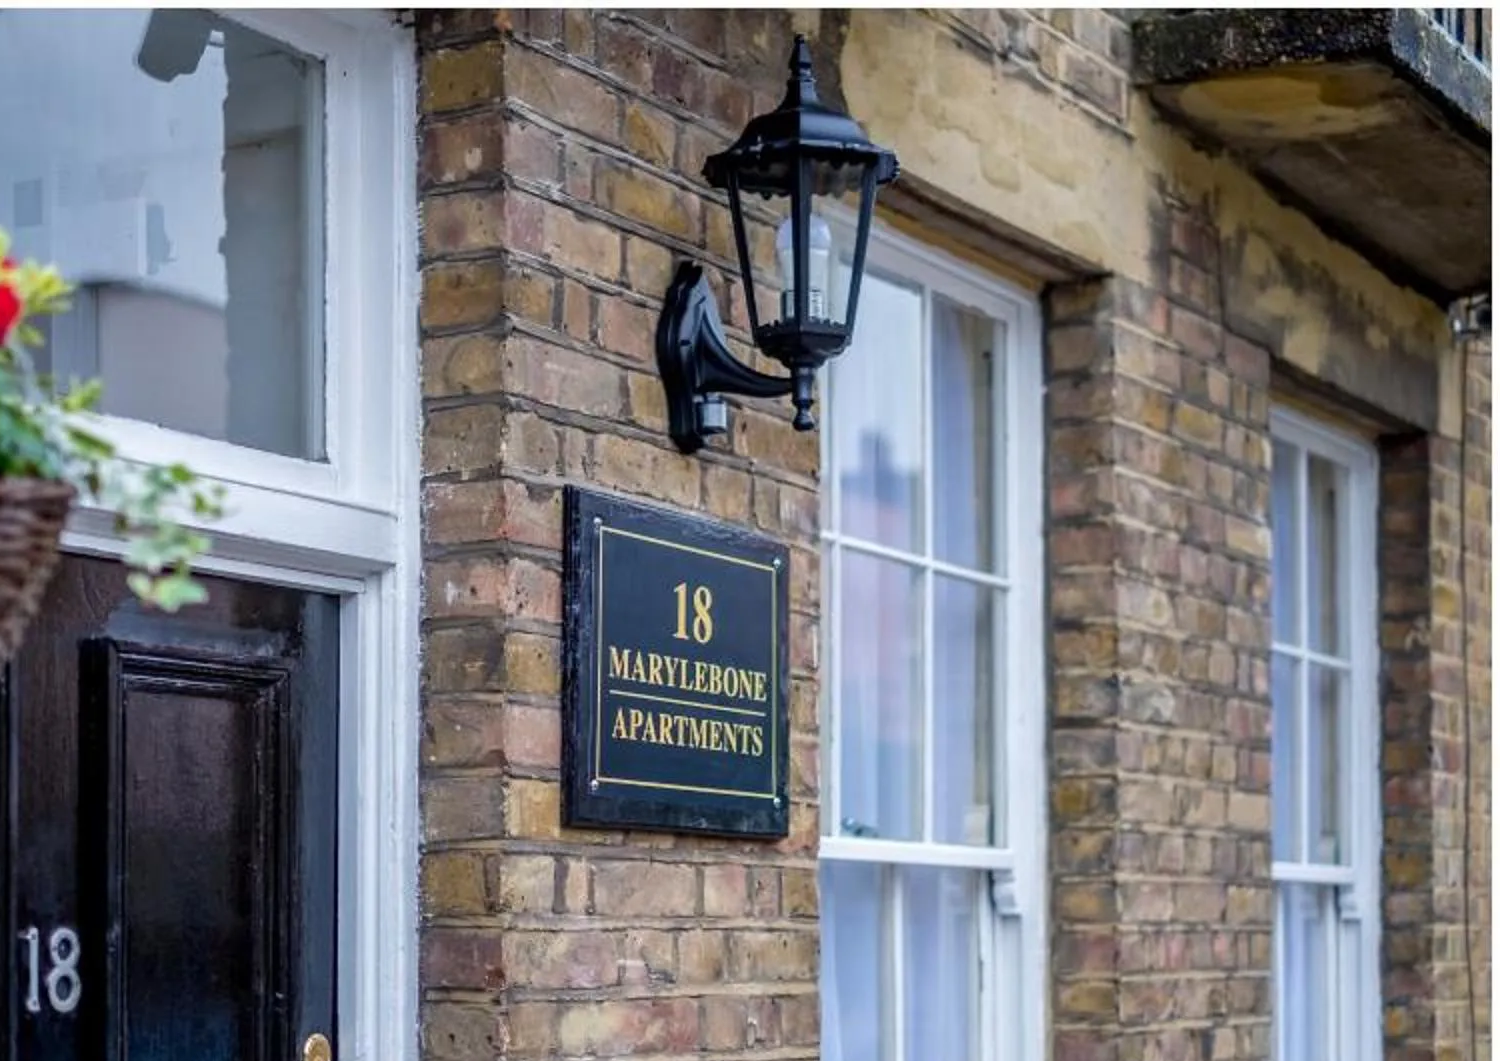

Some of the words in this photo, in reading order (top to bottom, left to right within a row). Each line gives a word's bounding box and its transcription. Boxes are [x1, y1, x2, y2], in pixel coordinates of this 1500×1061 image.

[672, 581, 713, 645] 18
[608, 645, 767, 702] MARYLEBONE
[611, 706, 764, 757] APARTMENTS
[18, 926, 81, 1013] 18
